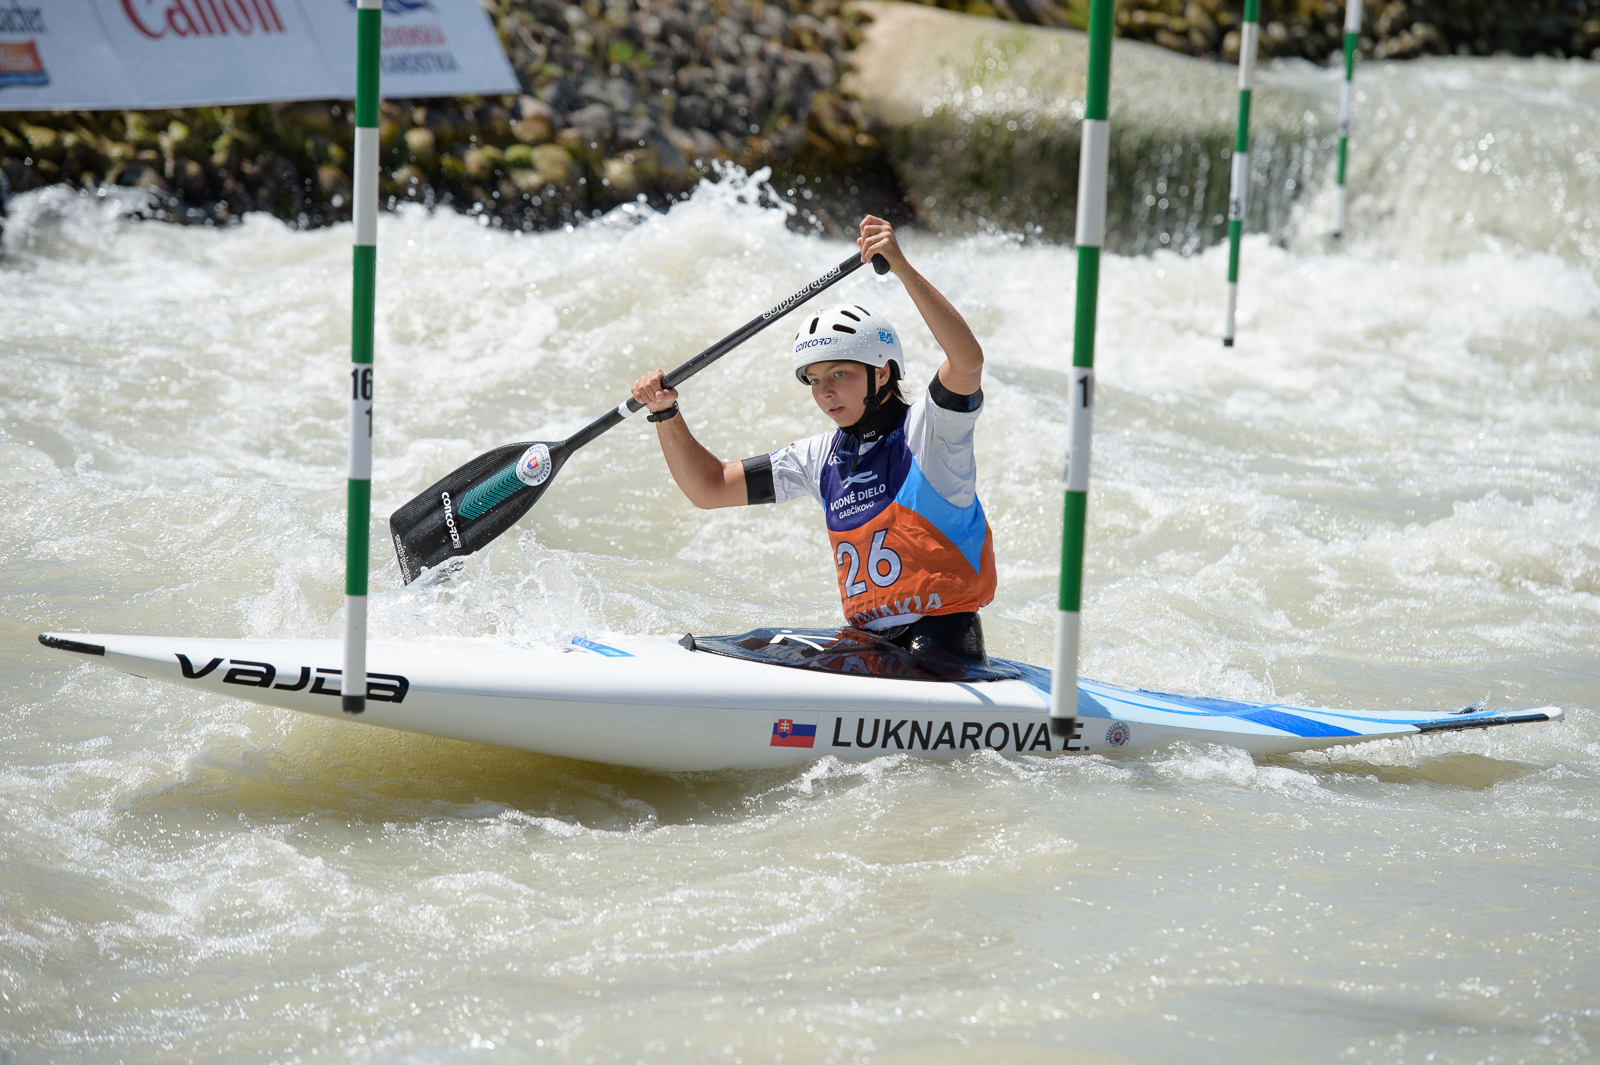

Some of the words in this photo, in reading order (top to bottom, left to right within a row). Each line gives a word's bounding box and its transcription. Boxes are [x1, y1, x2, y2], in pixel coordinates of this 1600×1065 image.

[762, 282, 812, 319] paddles
[351, 367, 373, 401] 16
[830, 490, 857, 511] VODNÉ
[857, 483, 886, 501] DIELO
[839, 500, 875, 519] GABČÍKOVO
[836, 527, 903, 599] 26
[831, 716, 1052, 752] LUKNAROVA
